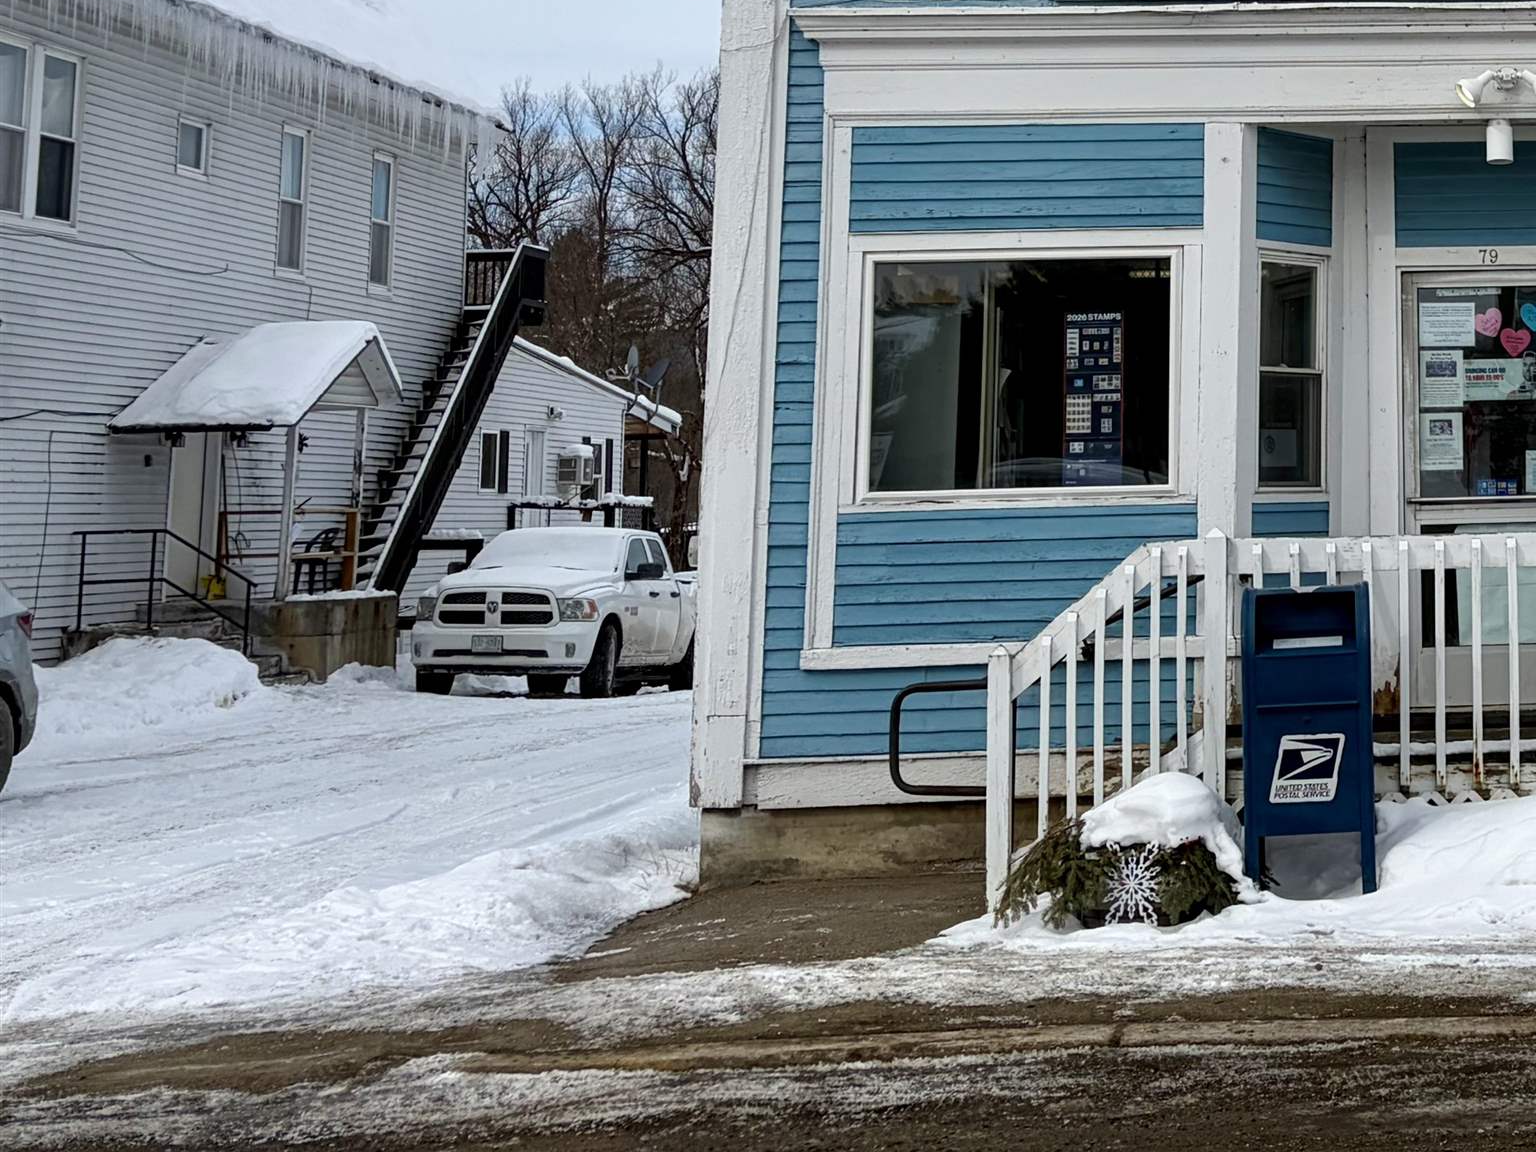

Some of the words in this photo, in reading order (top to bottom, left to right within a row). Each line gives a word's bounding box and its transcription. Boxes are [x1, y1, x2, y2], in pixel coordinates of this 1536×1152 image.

[1478, 249, 1499, 264] 79
[1087, 312, 1121, 321] STAMPS
[1303, 783, 1329, 791] STATES
